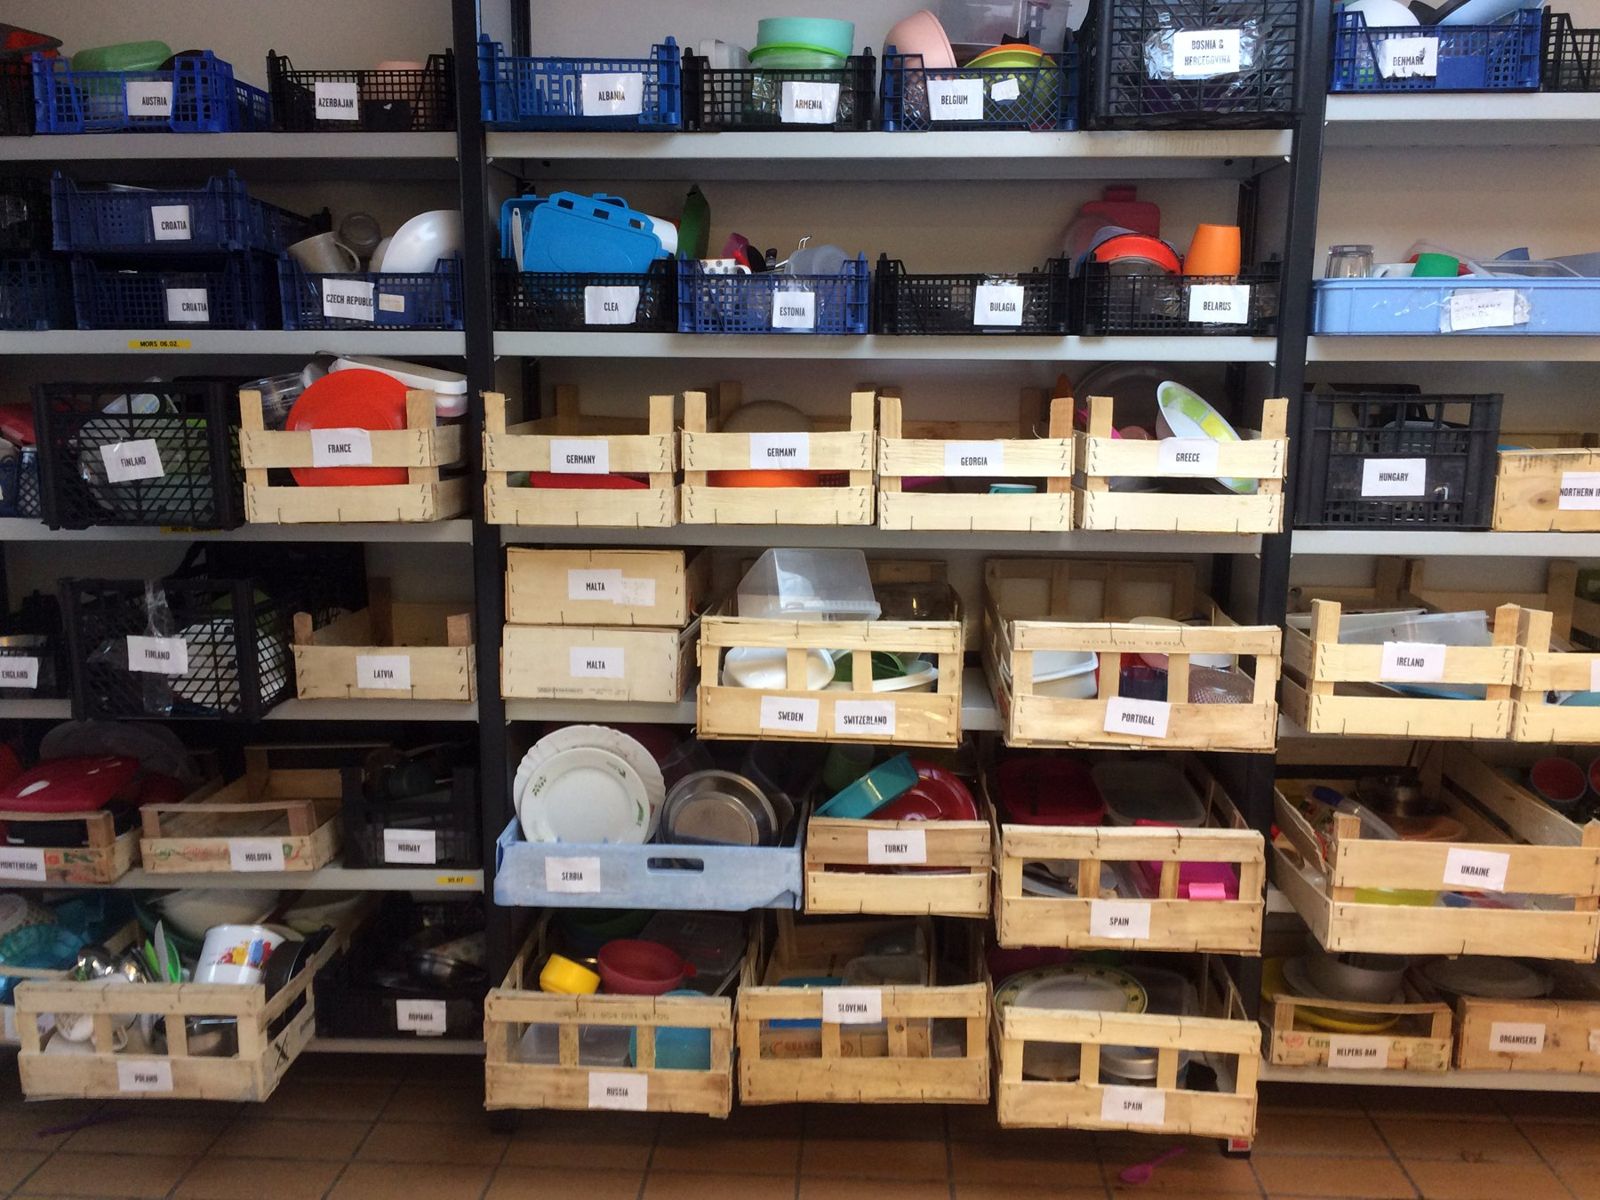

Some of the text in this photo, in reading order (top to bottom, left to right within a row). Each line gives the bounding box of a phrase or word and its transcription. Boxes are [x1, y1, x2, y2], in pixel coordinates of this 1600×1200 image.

[1191, 39, 1216, 50] BOSNIA
[1392, 55, 1425, 67] DENMARK
[141, 96, 168, 106] AUSTRIA
[598, 90, 626, 102] ALBANIA
[940, 94, 968, 105] BELGIUM
[318, 97, 354, 109] AZERBAJAN
[794, 99, 823, 110] ARMENIA
[160, 220, 188, 231] CROATIA
[325, 293, 345, 305] CZECH
[181, 302, 207, 312] CROATIA
[603, 301, 619, 312] CLEA
[989, 301, 1016, 312] BULAGIA
[1202, 300, 1232, 311] BELARUS
[779, 306, 806, 317] ESTONIA
[327, 443, 352, 454] FRANCE
[766, 447, 797, 457] GERMANY
[120, 455, 147, 467] FINLAND
[566, 454, 596, 465] GERMANY
[960, 456, 988, 467] GEORGIA
[1175, 452, 1201, 463] GREECE
[1378, 472, 1409, 482] HUNGARY
[1559, 487, 1594, 497] NORTHERN
[585, 582, 606, 591] MALTA
[144, 649, 171, 660] FINLAND
[586, 660, 606, 670] MALTA
[1396, 656, 1425, 668] IRELAND
[373, 669, 394, 679] LATVIA
[777, 710, 804, 722] SWEDEN
[843, 715, 888, 726] SWITZERLAND
[1121, 712, 1155, 726] PORTUGAL
[397, 843, 421, 853] NORWAY
[884, 844, 908, 854] TURKEY
[245, 852, 272, 862] MOLDOVA
[561, 871, 583, 881] SERBIA
[1460, 865, 1490, 878] UKRAINE
[1109, 916, 1130, 926] SPAIN
[837, 1003, 868, 1013] SLOVENIA
[1499, 1034, 1537, 1045] ORGANISERS
[606, 1087, 629, 1097] RUSSIA
[1123, 1100, 1143, 1111] SPAIN
